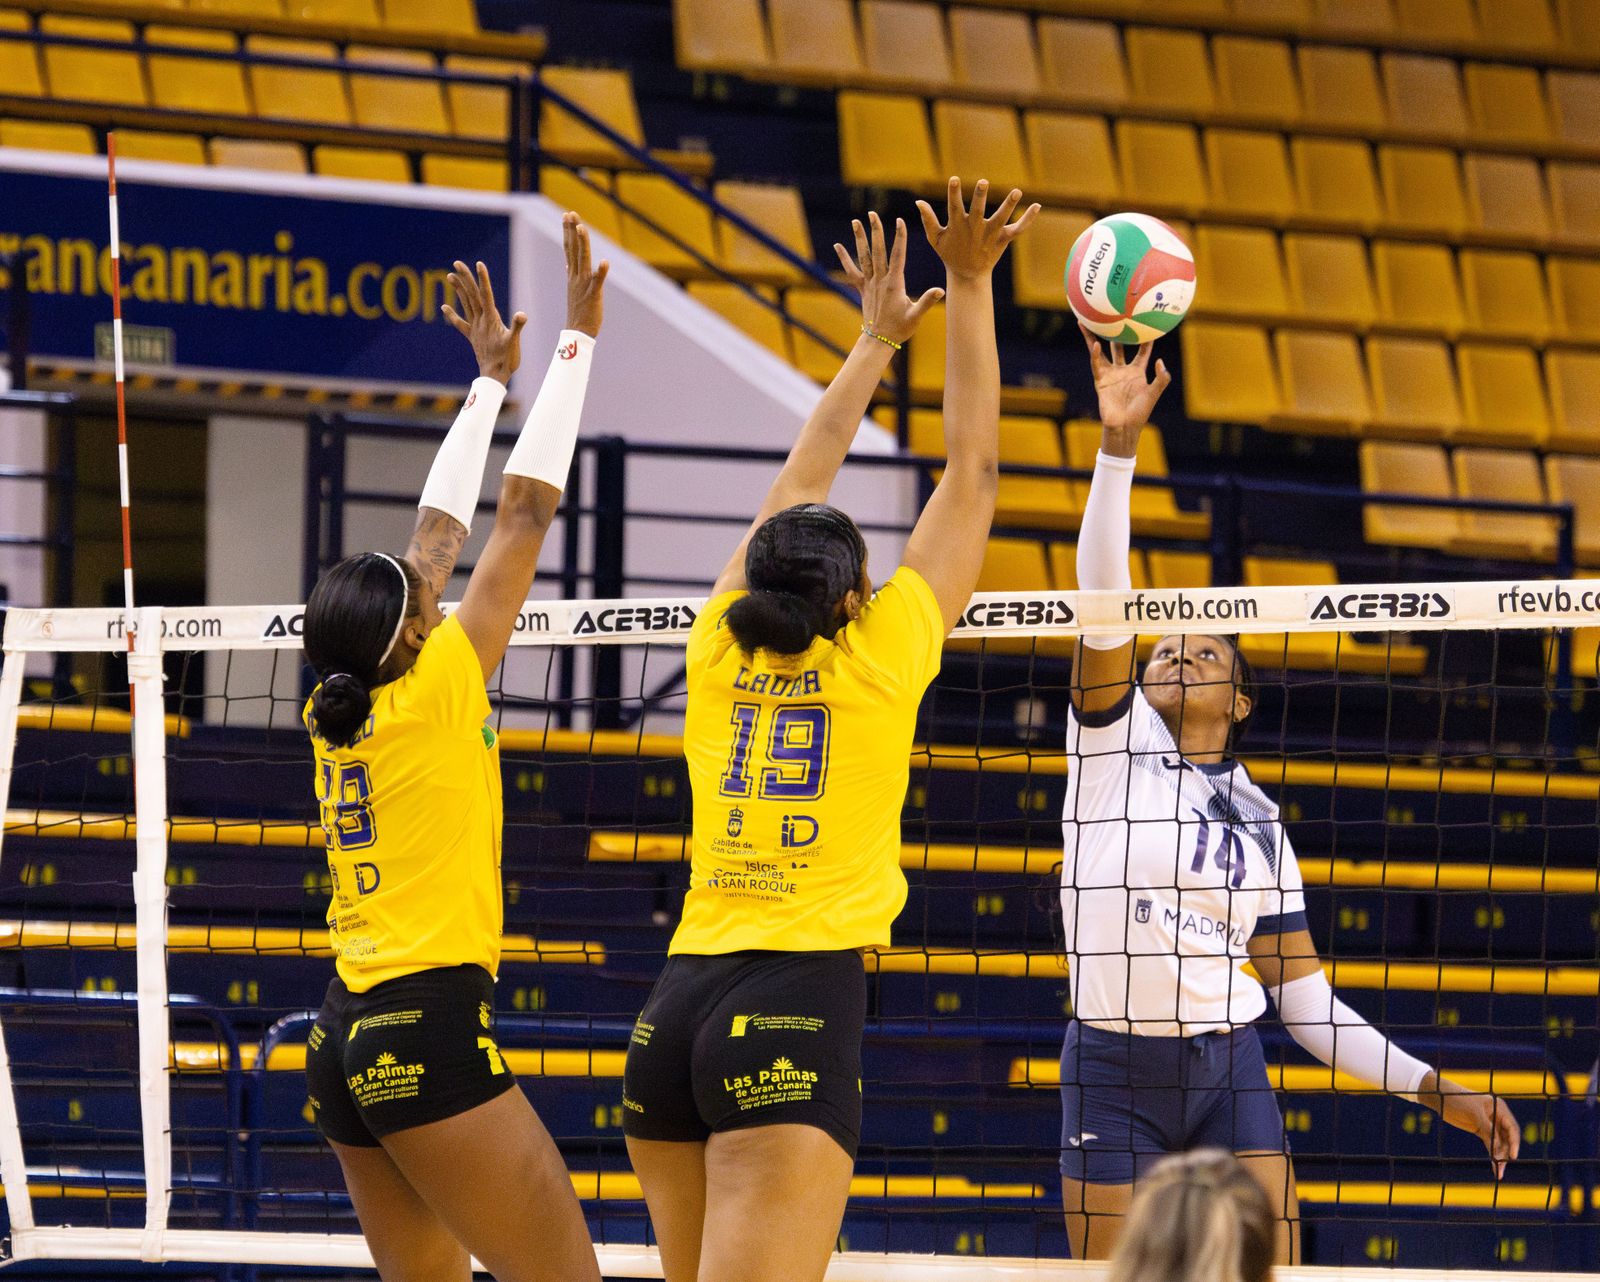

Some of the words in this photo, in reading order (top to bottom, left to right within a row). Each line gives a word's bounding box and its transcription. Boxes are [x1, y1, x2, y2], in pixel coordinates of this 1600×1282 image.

[1084, 242, 1111, 295] molten
[956, 600, 1075, 627] CERBIS
[1124, 593, 1258, 621] rfevb.com
[733, 666, 822, 697] LAURA
[718, 701, 831, 801] 19
[1191, 807, 1247, 889] 14
[721, 878, 746, 889] SAN
[749, 879, 797, 894] ROQUE
[1164, 908, 1246, 947] MADRID
[346, 1073, 364, 1090] Las
[367, 1064, 425, 1081] Palmas
[363, 1081, 382, 1091] Gran
[384, 1075, 418, 1087] Canaria
[723, 1075, 753, 1092] Las
[759, 1068, 818, 1084] Palmas
[735, 1089, 747, 1098] de
[750, 1084, 774, 1095] Gran
[777, 1080, 811, 1090] Canaria
[737, 1095, 759, 1105] Ciudad
[740, 1103, 753, 1111] City
